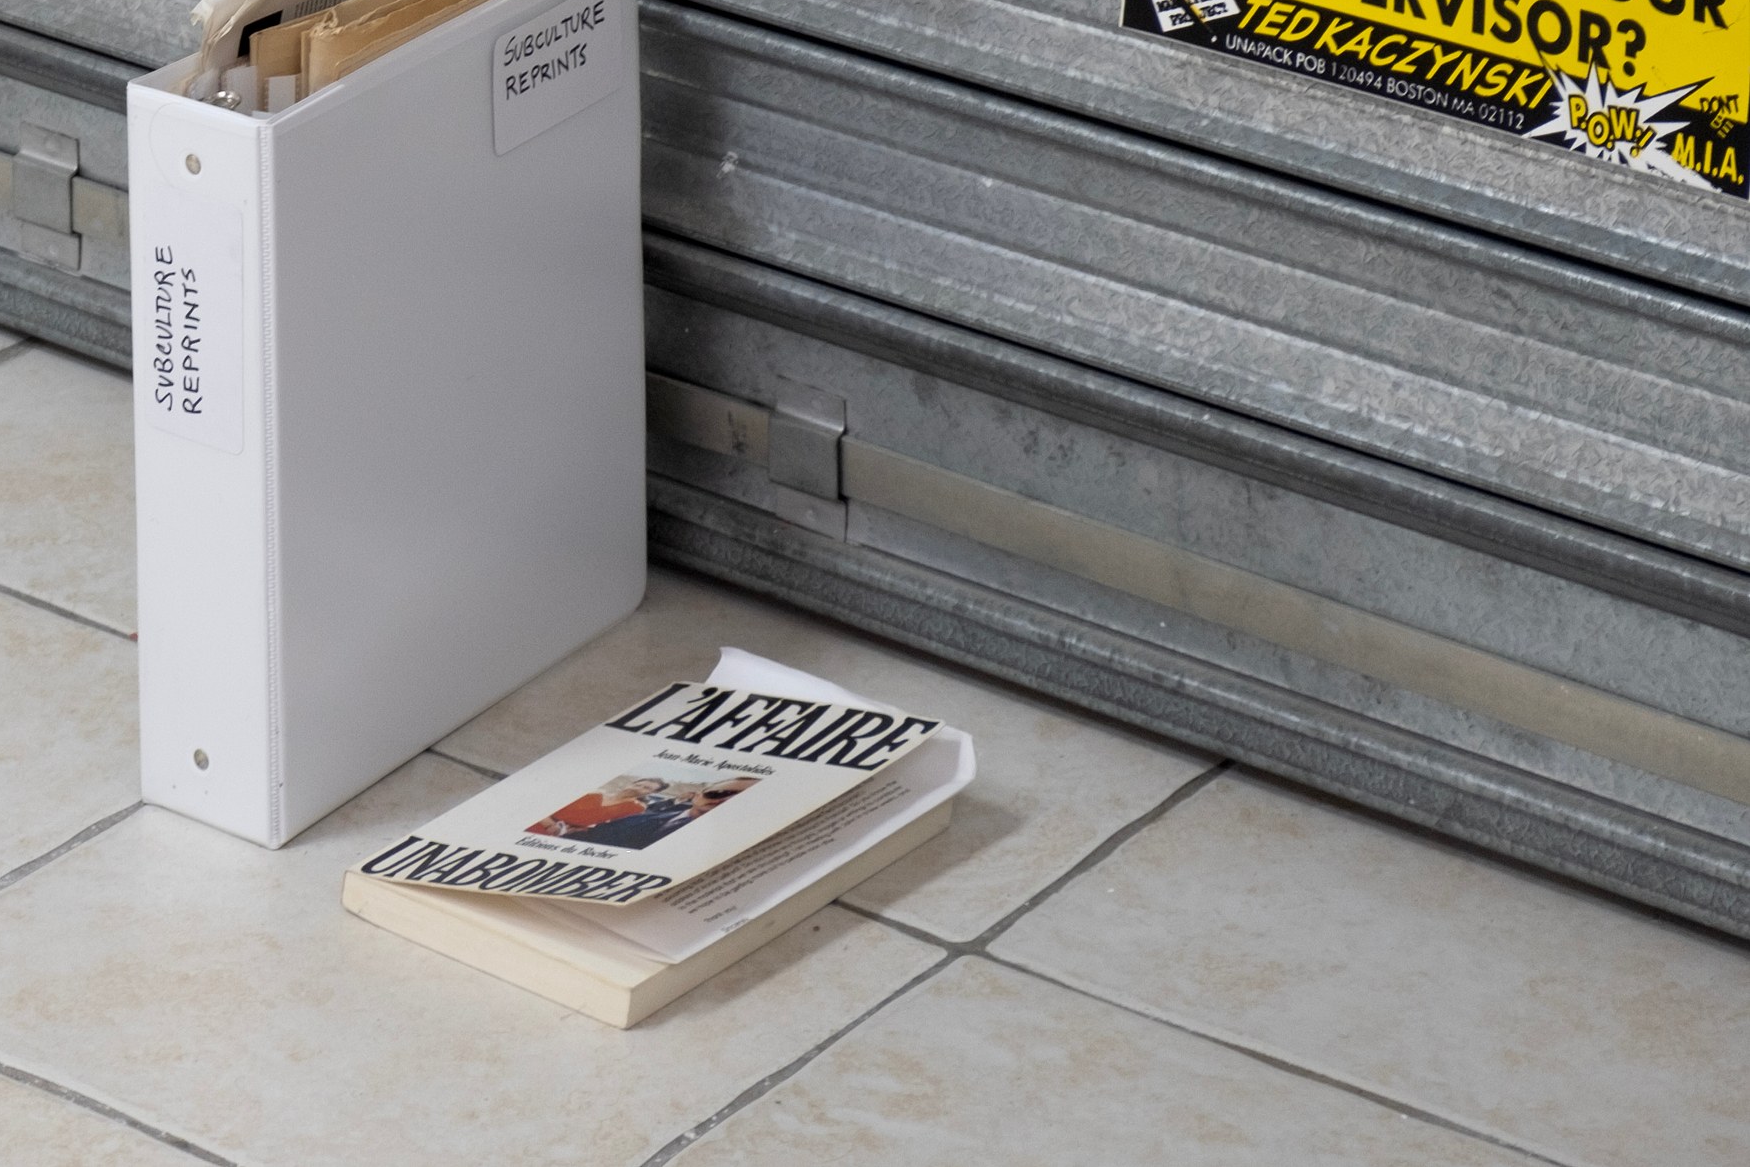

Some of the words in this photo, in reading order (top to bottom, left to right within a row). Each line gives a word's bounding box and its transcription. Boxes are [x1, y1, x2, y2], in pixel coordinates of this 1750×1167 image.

[503, 0, 606, 67] SUBCULTURE
[504, 43, 588, 101] REPRINTS
[1317, 16, 1553, 109] KACZYNSKI
[1226, 34, 1294, 67] UNAPACK
[1296, 51, 1326, 75] POB
[1331, 61, 1383, 93] 120494
[1386, 76, 1449, 109] BOSTON
[1452, 96, 1475, 116] MA
[1478, 102, 1525, 130] 02112
[1671, 132, 1744, 184] M.I.A.
[153, 245, 176, 411] SUBCULTURE
[181, 267, 202, 414] REPRINTS
[605, 681, 941, 772] L'AFFAIRE
[361, 836, 673, 904] UNABOMBER
